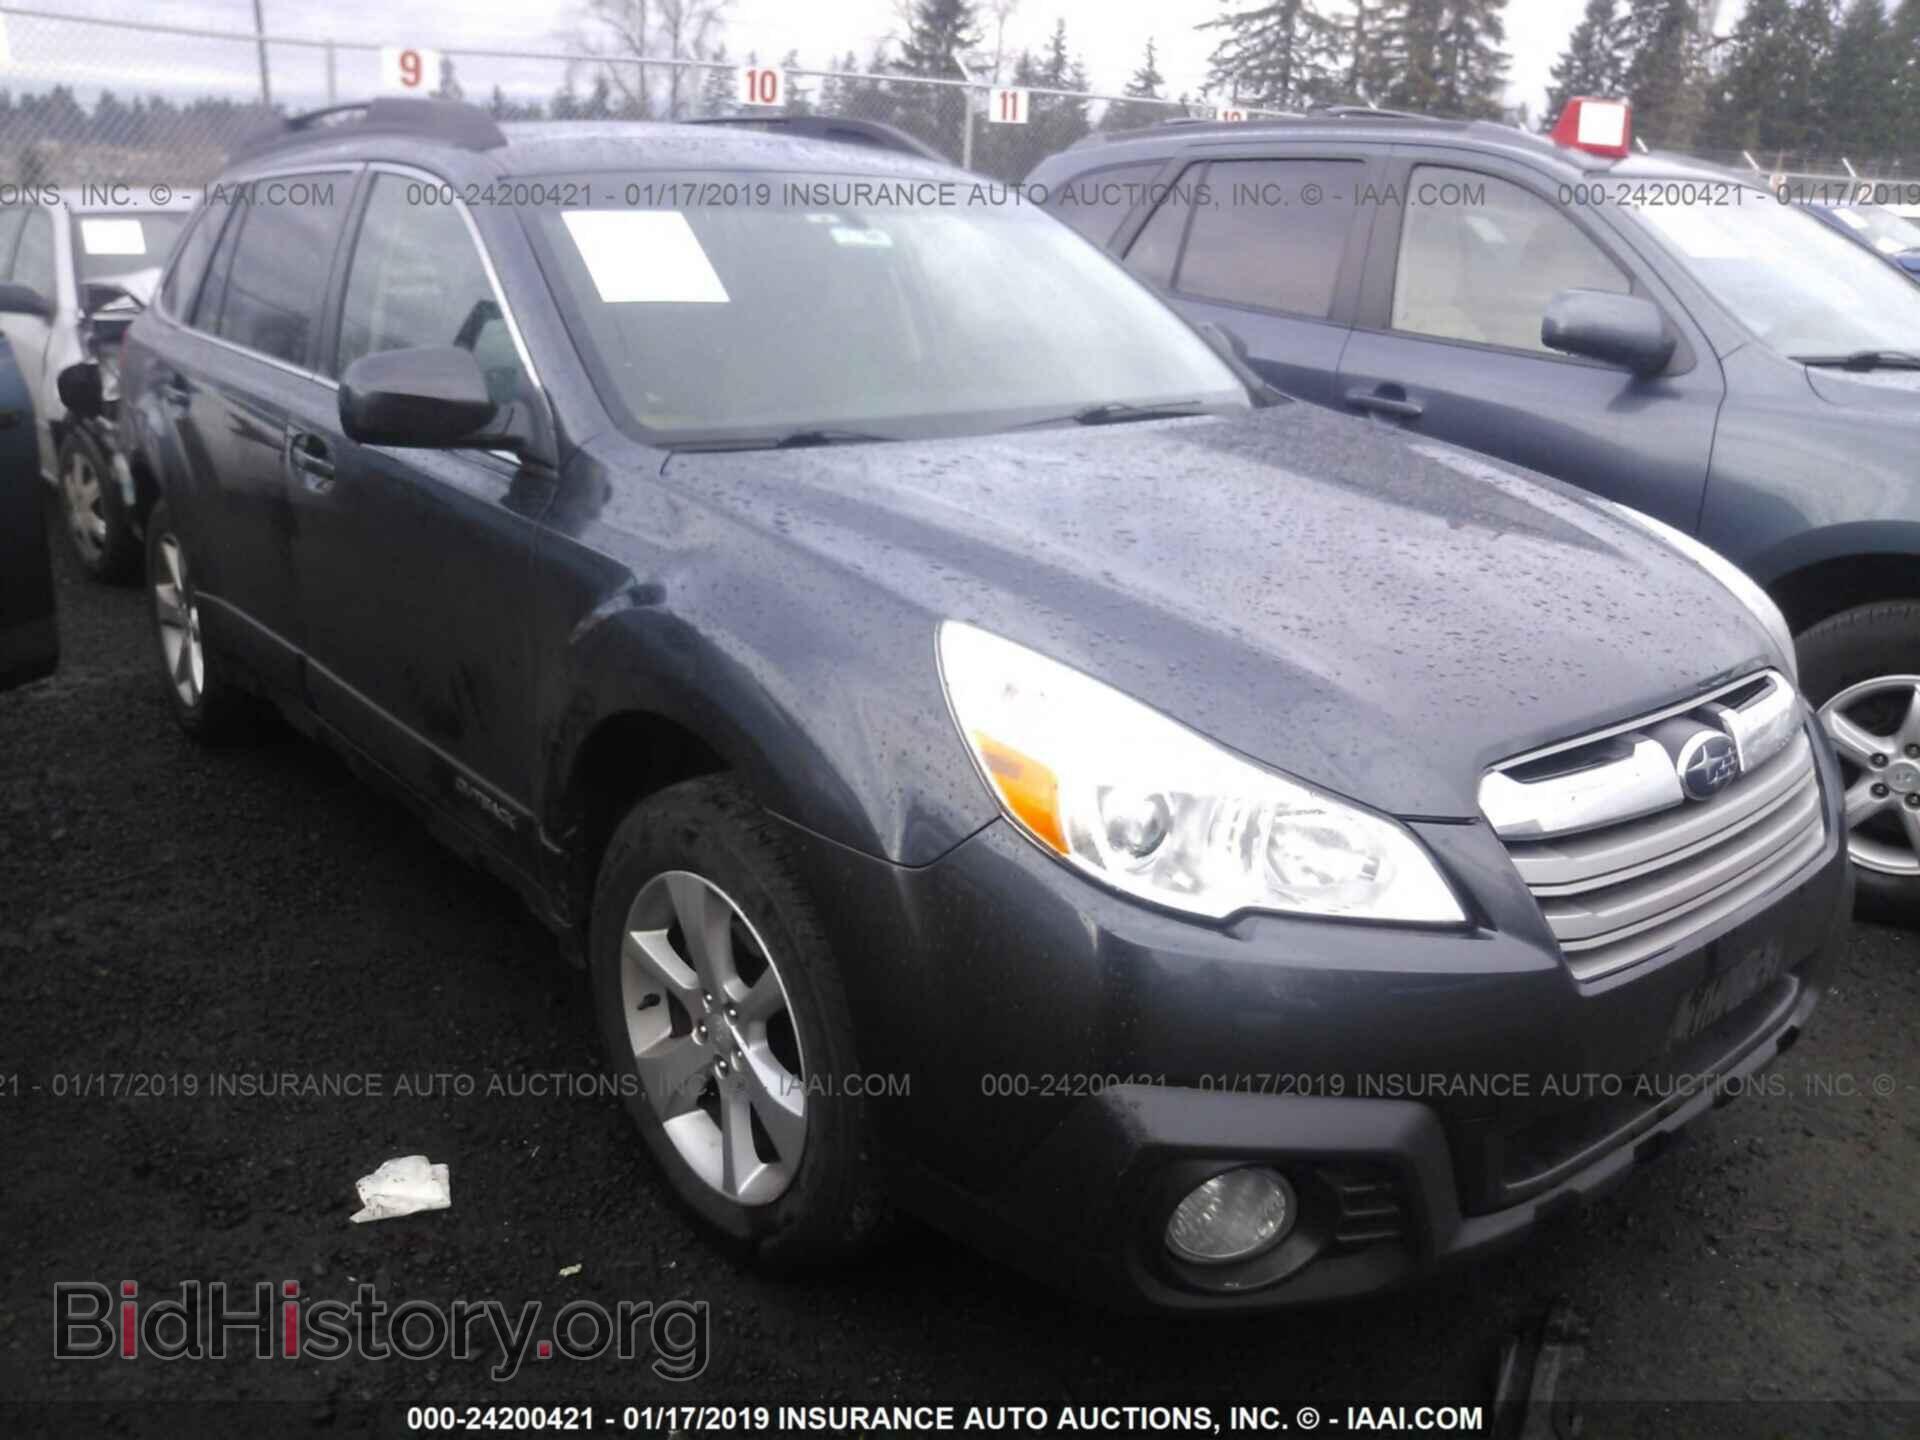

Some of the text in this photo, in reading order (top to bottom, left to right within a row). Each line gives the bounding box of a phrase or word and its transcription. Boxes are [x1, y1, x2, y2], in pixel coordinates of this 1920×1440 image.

[399, 50, 421, 88] 9
[747, 69, 778, 103] 10
[1000, 91, 1019, 121] 11
